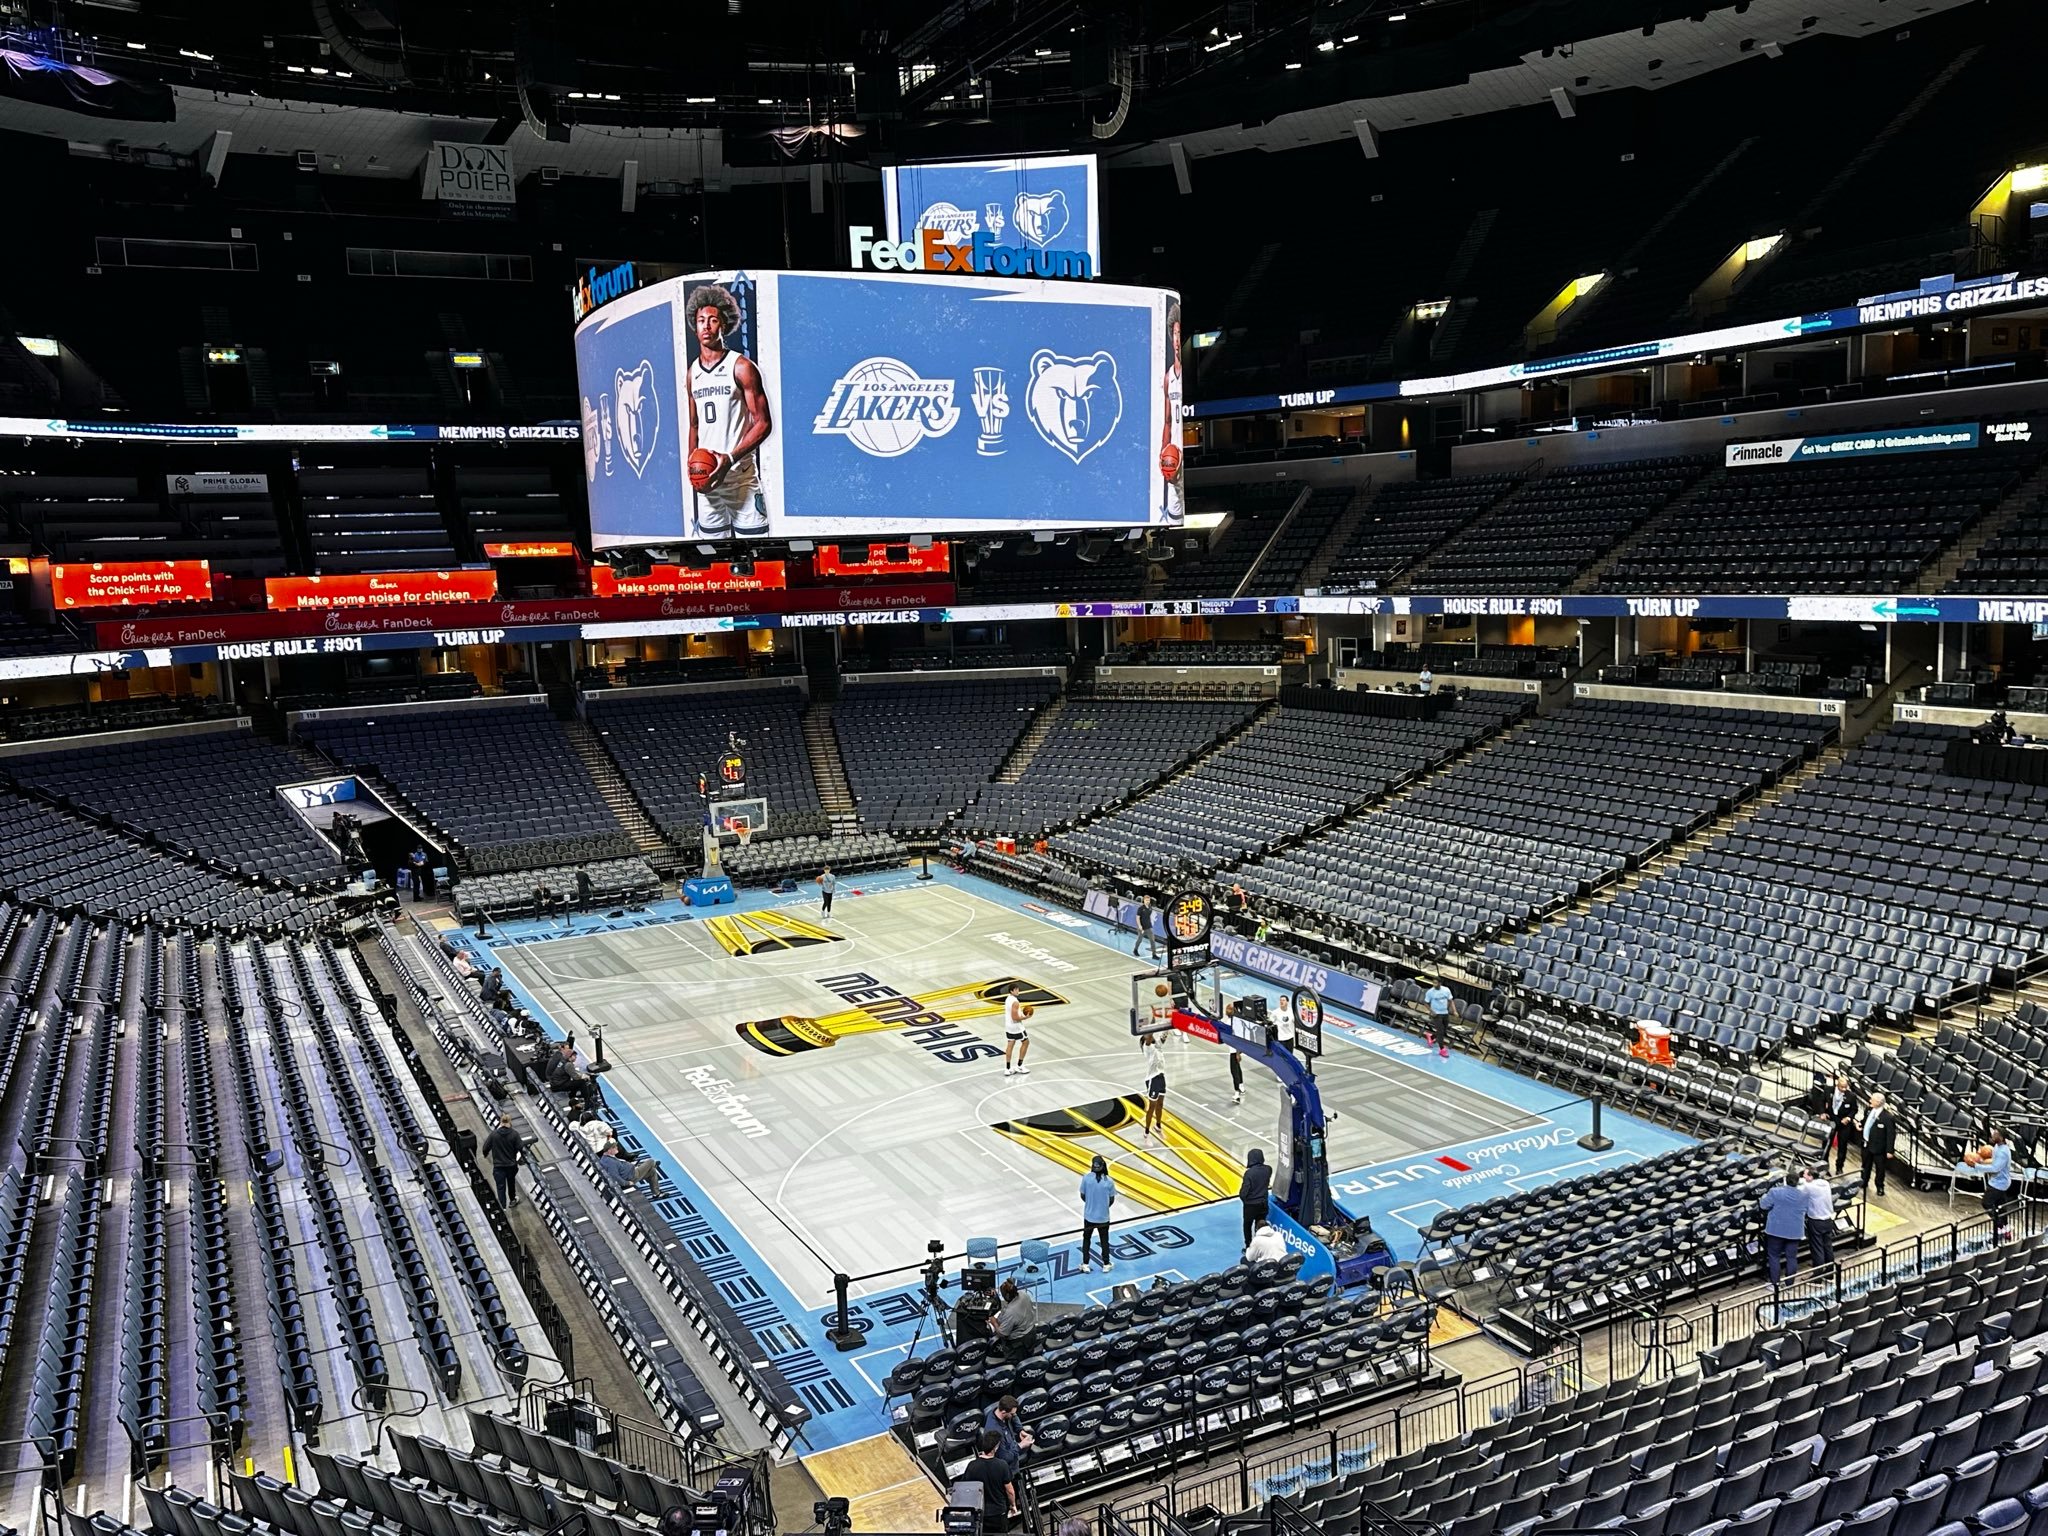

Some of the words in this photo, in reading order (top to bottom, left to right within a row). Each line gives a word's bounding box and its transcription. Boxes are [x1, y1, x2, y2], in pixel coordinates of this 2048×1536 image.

[849, 226, 1093, 280] FedExForum
[1859, 294, 1942, 324] MEMPHIS
[1945, 277, 2048, 310] GRIZZLIES
[693, 385, 731, 399] MEMPHIS
[862, 383, 887, 392] LOS
[888, 383, 949, 392] ANGELES
[1279, 392, 1313, 407] TURN
[1315, 390, 1335, 404] UP
[704, 401, 717, 424] 0
[820, 384, 957, 432] LAKERS
[439, 426, 506, 439] MEMPHIS
[508, 426, 580, 439] GRIZZLIES
[1732, 445, 1783, 461] Pinnacle
[1801, 445, 1814, 456] Get
[1814, 443, 1831, 454] Your
[1876, 439, 1885, 449] at
[229, 477, 261, 485] GLOBAL
[90, 573, 119, 583] Score
[121, 572, 151, 584] points
[153, 571, 174, 581] with
[617, 581, 646, 593] Make
[648, 582, 675, 592] some
[678, 580, 705, 590] noise
[706, 579, 722, 589] for
[724, 578, 762, 589] chicken
[88, 586, 105, 596] the
[163, 584, 182, 595] App
[297, 595, 329, 606] Make
[333, 595, 366, 605] some
[369, 592, 402, 603] noise
[403, 591, 422, 601] for
[424, 589, 470, 600] chicken
[709, 603, 750, 614] FanDeck
[885, 595, 927, 606] FanDeck
[1173, 602, 1192, 614] 3:49
[1257, 600, 1267, 613] 5
[1443, 598, 1488, 615] HOUSE
[1490, 598, 1525, 615] RULE
[1529, 598, 1563, 616] #901
[1626, 598, 1673, 616] TURN
[1675, 598, 1700, 616] UP
[554, 610, 600, 621] FanDeck
[1085, 604, 1094, 616] 2
[383, 617, 433, 629] FanDeck
[781, 610, 846, 628] MEMPHIS
[848, 609, 920, 625] GRIZZLIES
[178, 628, 226, 641] FanDeck
[434, 631, 478, 647] TURN
[480, 630, 505, 645] UP
[217, 643, 271, 660] HOUSE
[274, 638, 318, 656] RULE
[323, 637, 363, 653] #901
[1823, 703, 1836, 713] 105
[1905, 709, 1918, 719] 104
[1180, 899, 1203, 915] 3:49
[487, 913, 695, 947] GRIZZLIES
[984, 931, 1080, 972] FedExForum
[1183, 943, 1209, 953] TISSOT
[1245, 946, 1328, 993] GRIZZLIES
[815, 972, 1006, 1063] MEMPHIS
[679, 1064, 772, 1139] FedExForum
[1466, 1128, 1578, 1164] Michelob
[1442, 1164, 1521, 1189] Courtside
[1267, 1221, 1316, 1258] oinbase
